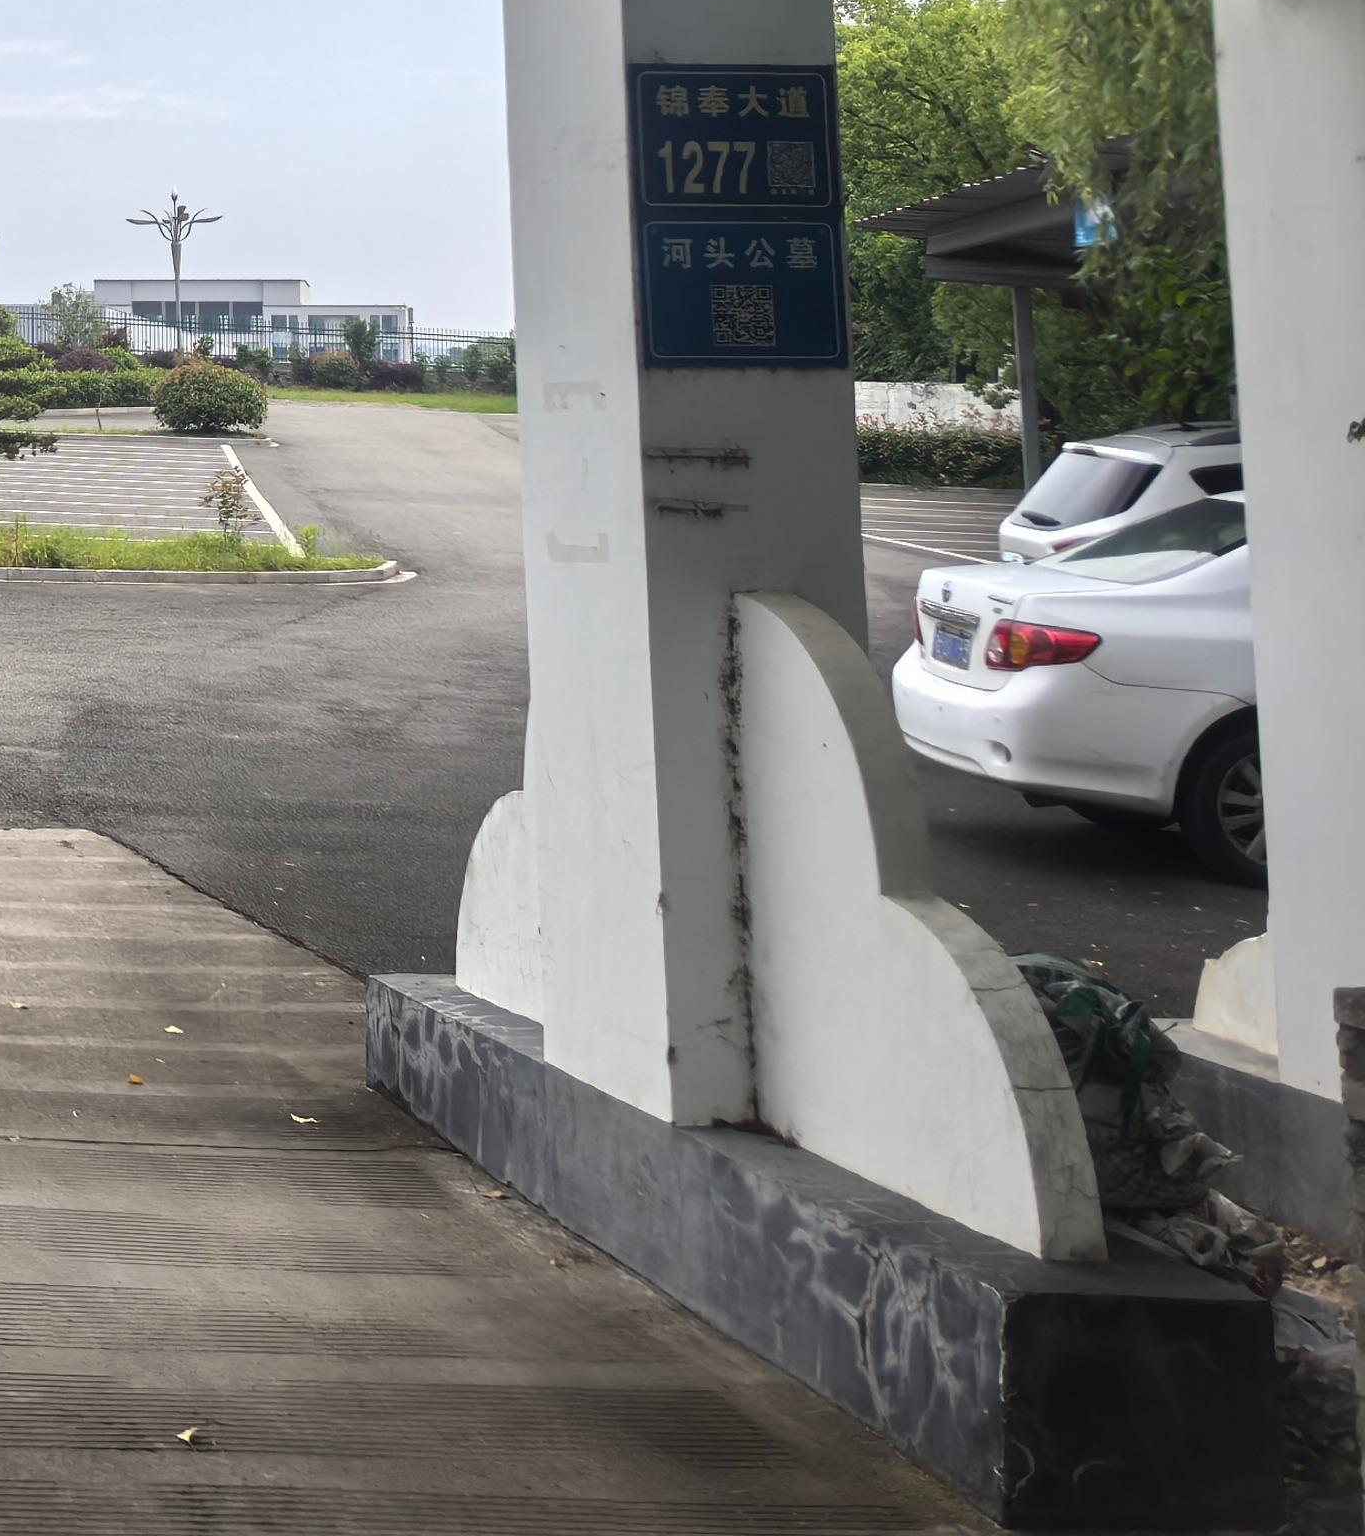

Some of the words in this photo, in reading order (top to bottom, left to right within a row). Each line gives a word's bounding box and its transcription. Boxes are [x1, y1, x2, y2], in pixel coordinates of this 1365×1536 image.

[656, 84, 813, 118] 锦奉大道
[657, 140, 756, 195] 1277
[661, 236, 818, 270] 河头公墓
